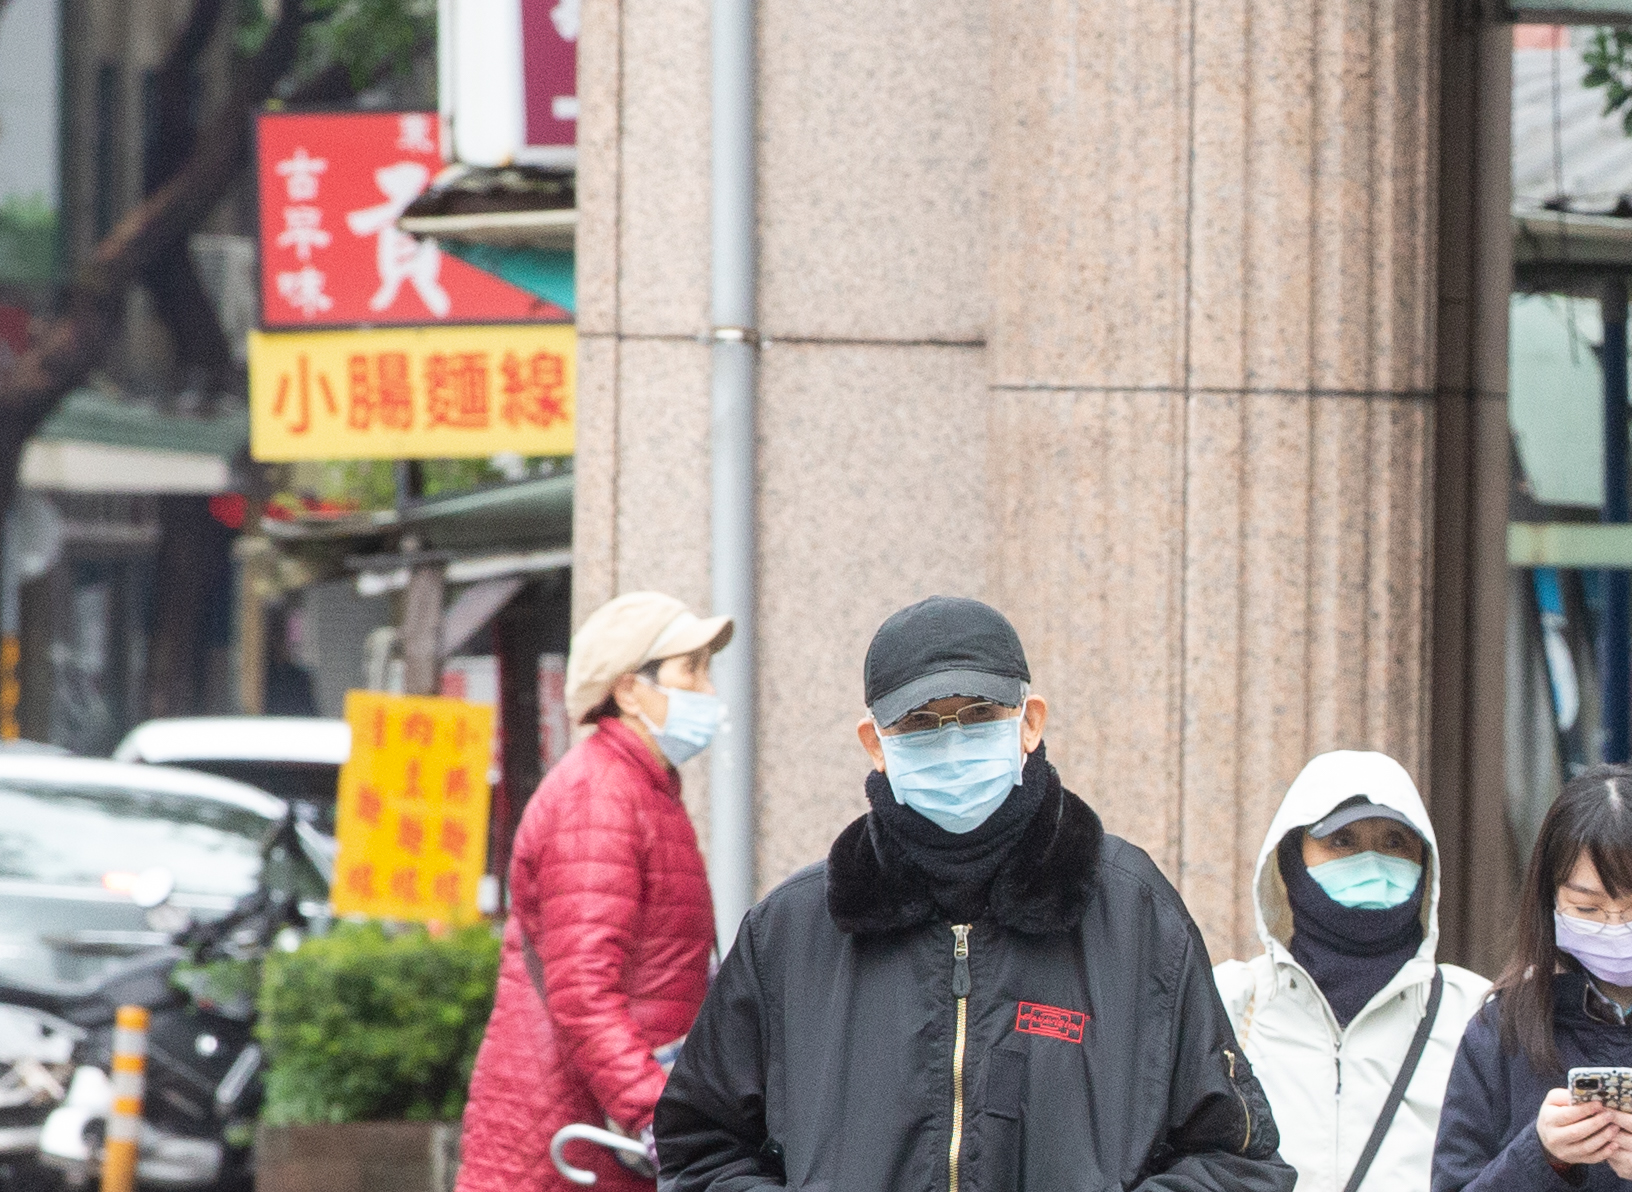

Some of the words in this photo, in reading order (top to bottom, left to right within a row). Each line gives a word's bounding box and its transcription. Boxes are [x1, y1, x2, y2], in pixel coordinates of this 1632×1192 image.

[273, 148, 334, 317] 古早味
[271, 352, 569, 434] 小腸麵線
